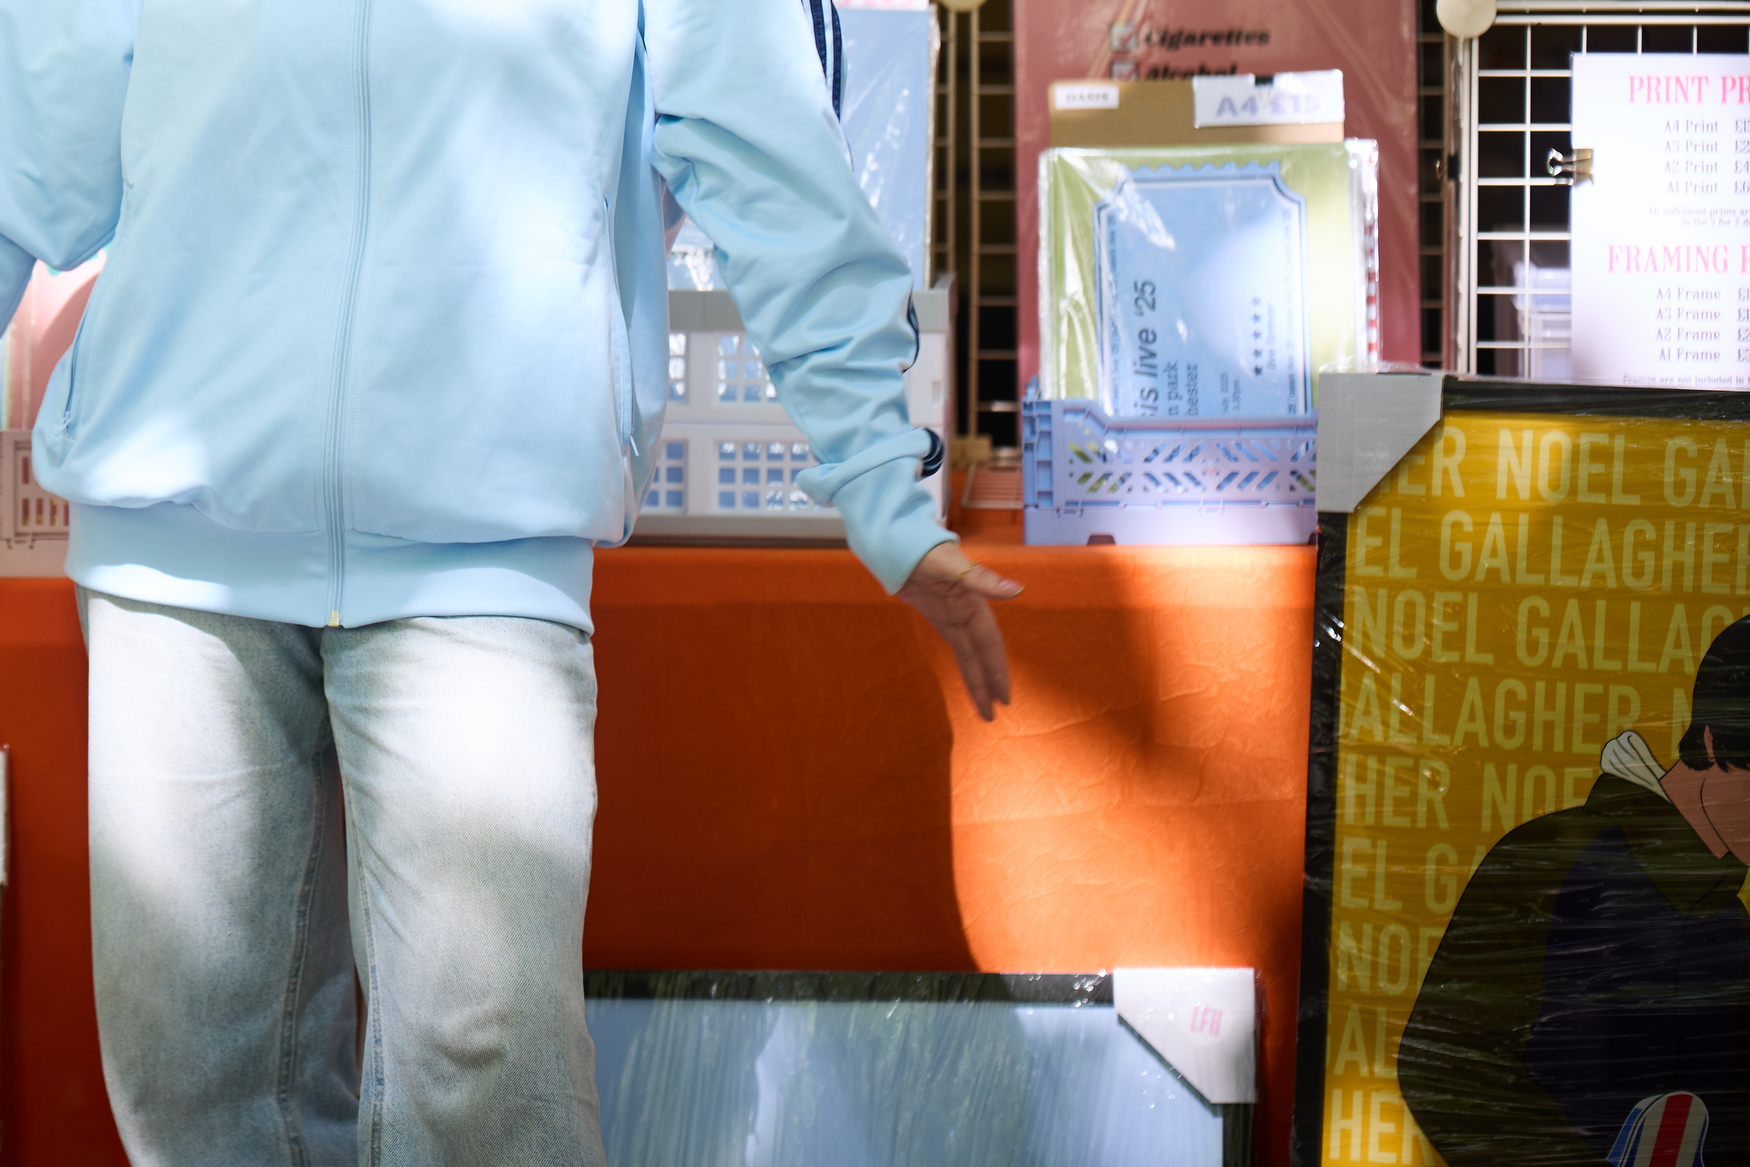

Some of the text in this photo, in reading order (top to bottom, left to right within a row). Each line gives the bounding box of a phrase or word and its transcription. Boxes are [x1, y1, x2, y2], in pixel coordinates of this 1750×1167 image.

[1144, 26, 1271, 51] Cigarettes
[1065, 91, 1110, 104] OASIS
[1628, 75, 1709, 104] PRINT
[1215, 93, 1320, 118] A4 £15
[1664, 119, 1718, 133] A4 Print
[1664, 139, 1680, 154] A3
[1685, 139, 1718, 154] Print
[1663, 160, 1680, 175] A2
[1685, 160, 1718, 175] Print
[1685, 181, 1718, 194] Print
[1663, 208, 1706, 218] unframed
[1710, 208, 1737, 218] prints
[1607, 244, 1728, 274] FRAMING
[1656, 287, 1671, 301] A4
[1677, 287, 1721, 301] Frame
[1656, 307, 1671, 321] A3
[1677, 307, 1721, 321] Frame
[1133, 279, 1158, 378] live '25
[1265, 302, 1277, 371] live forever
[1656, 327, 1671, 341] A2
[1677, 327, 1721, 341] Frame
[1659, 348, 1721, 362] A1 Frame
[1163, 360, 1183, 401] park
[1186, 362, 1199, 416] hester
[1623, 374, 1656, 384] Frames
[1695, 374, 1732, 384] included
[1495, 426, 1750, 511] NOEL GA
[1354, 507, 1417, 580] EL
[1351, 587, 1494, 665] NOEL
[1339, 671, 1642, 754] ALLAGHER
[1344, 753, 1450, 831] HER
[1340, 837, 1403, 911] EL
[1189, 1006, 1223, 1037] LFH
